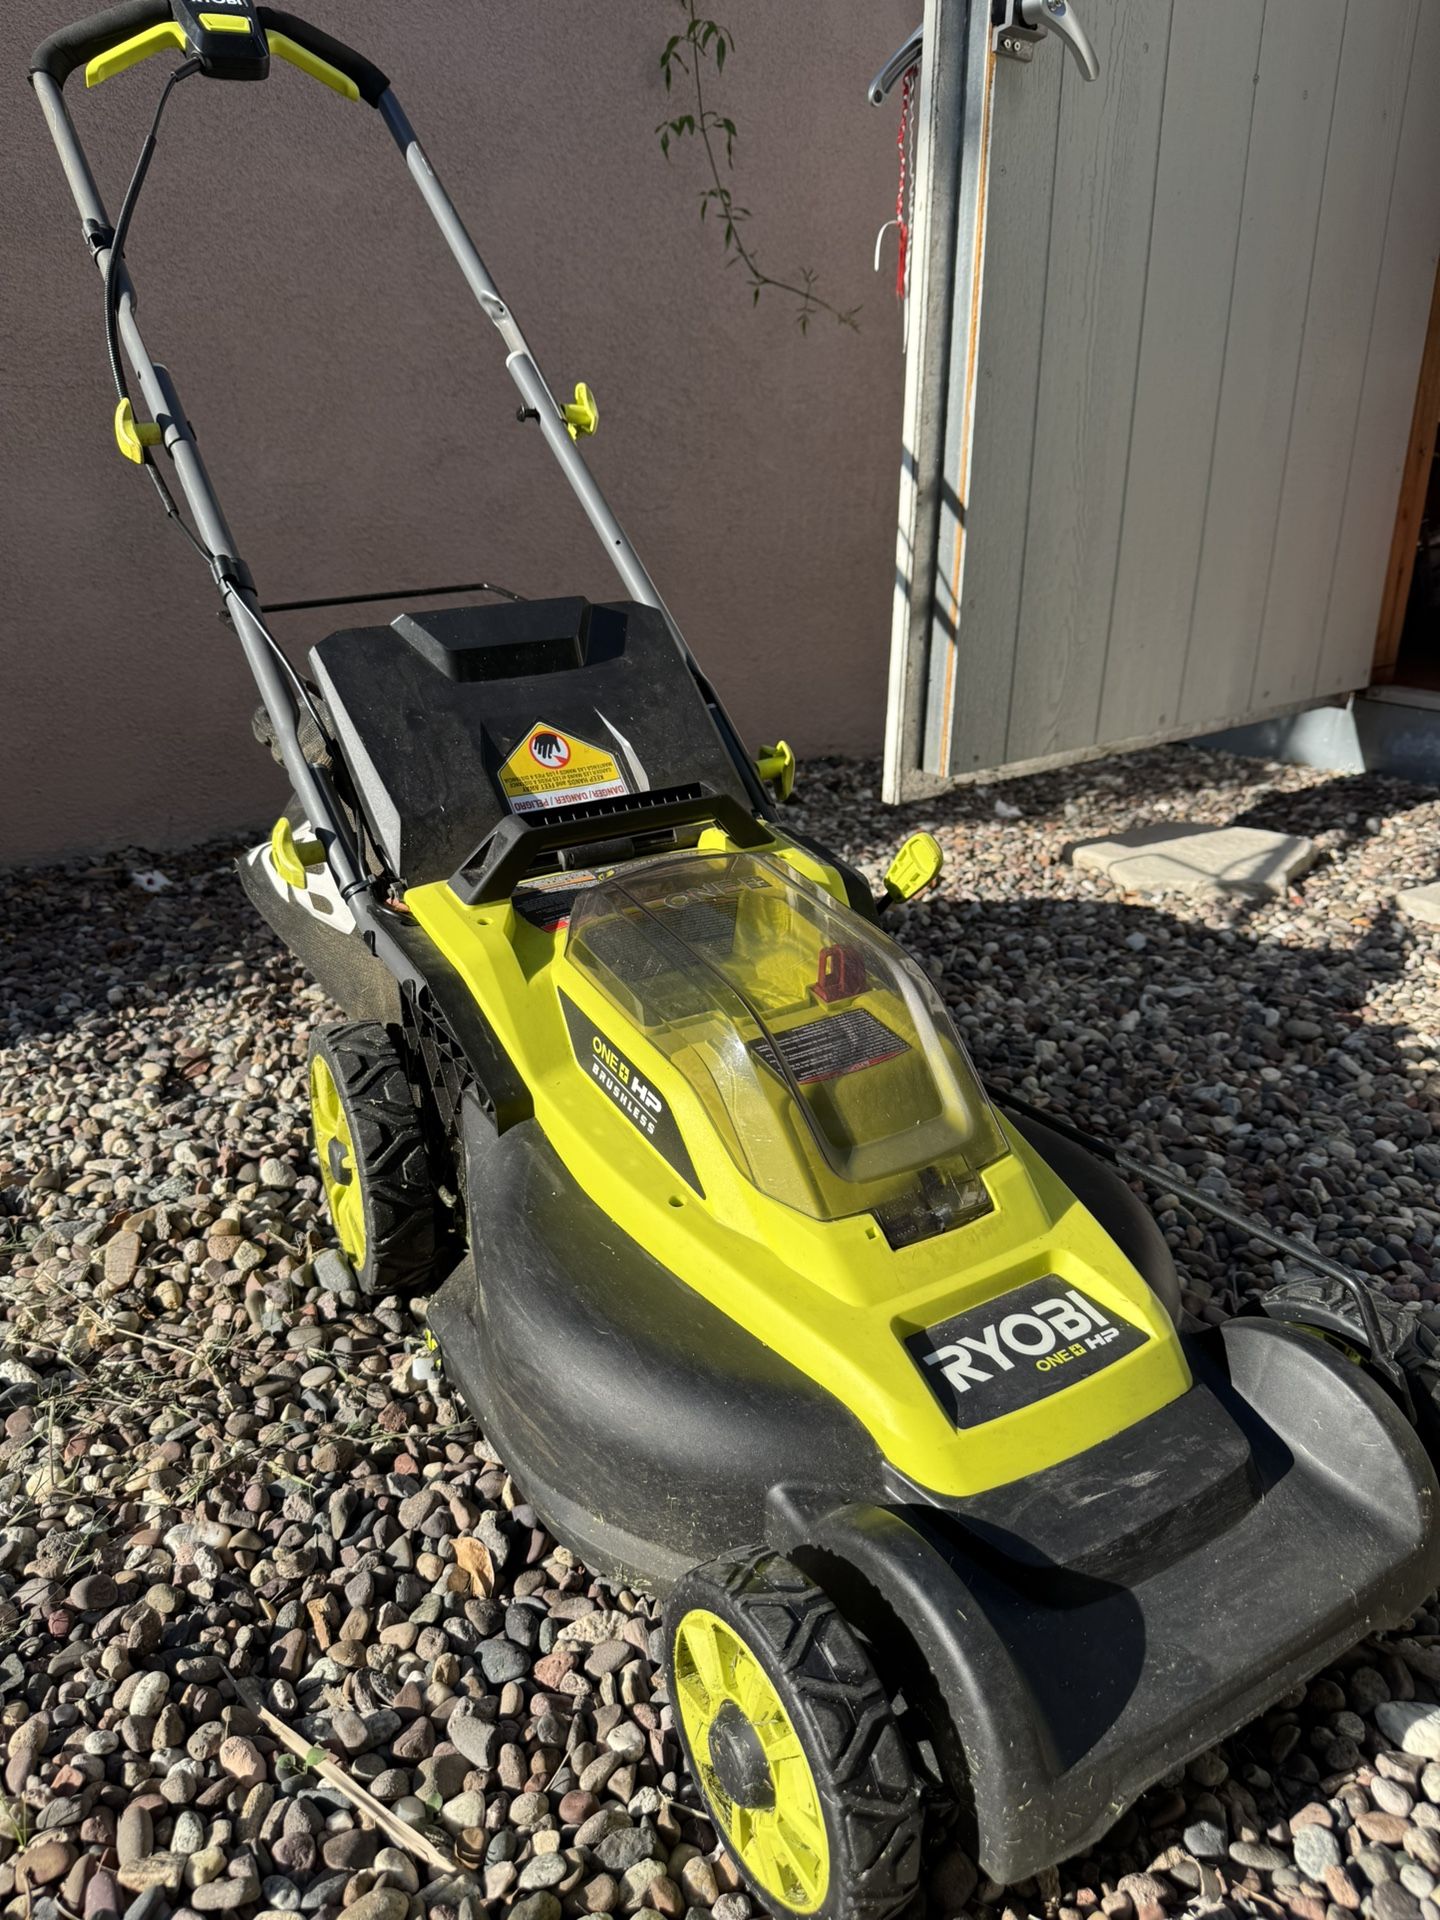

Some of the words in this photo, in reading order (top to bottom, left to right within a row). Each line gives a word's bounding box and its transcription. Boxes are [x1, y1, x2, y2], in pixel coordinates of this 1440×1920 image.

[567, 777, 588, 785] HANDS
[554, 791, 589, 805] DANGER
[592, 785, 625, 798] DANGER
[514, 797, 550, 812] PELIGRO
[592, 1063, 655, 1134] BRUSHLESS
[631, 1076, 662, 1113] HP
[923, 1290, 1109, 1393] RYOBI
[1084, 1327, 1120, 1350] HP
